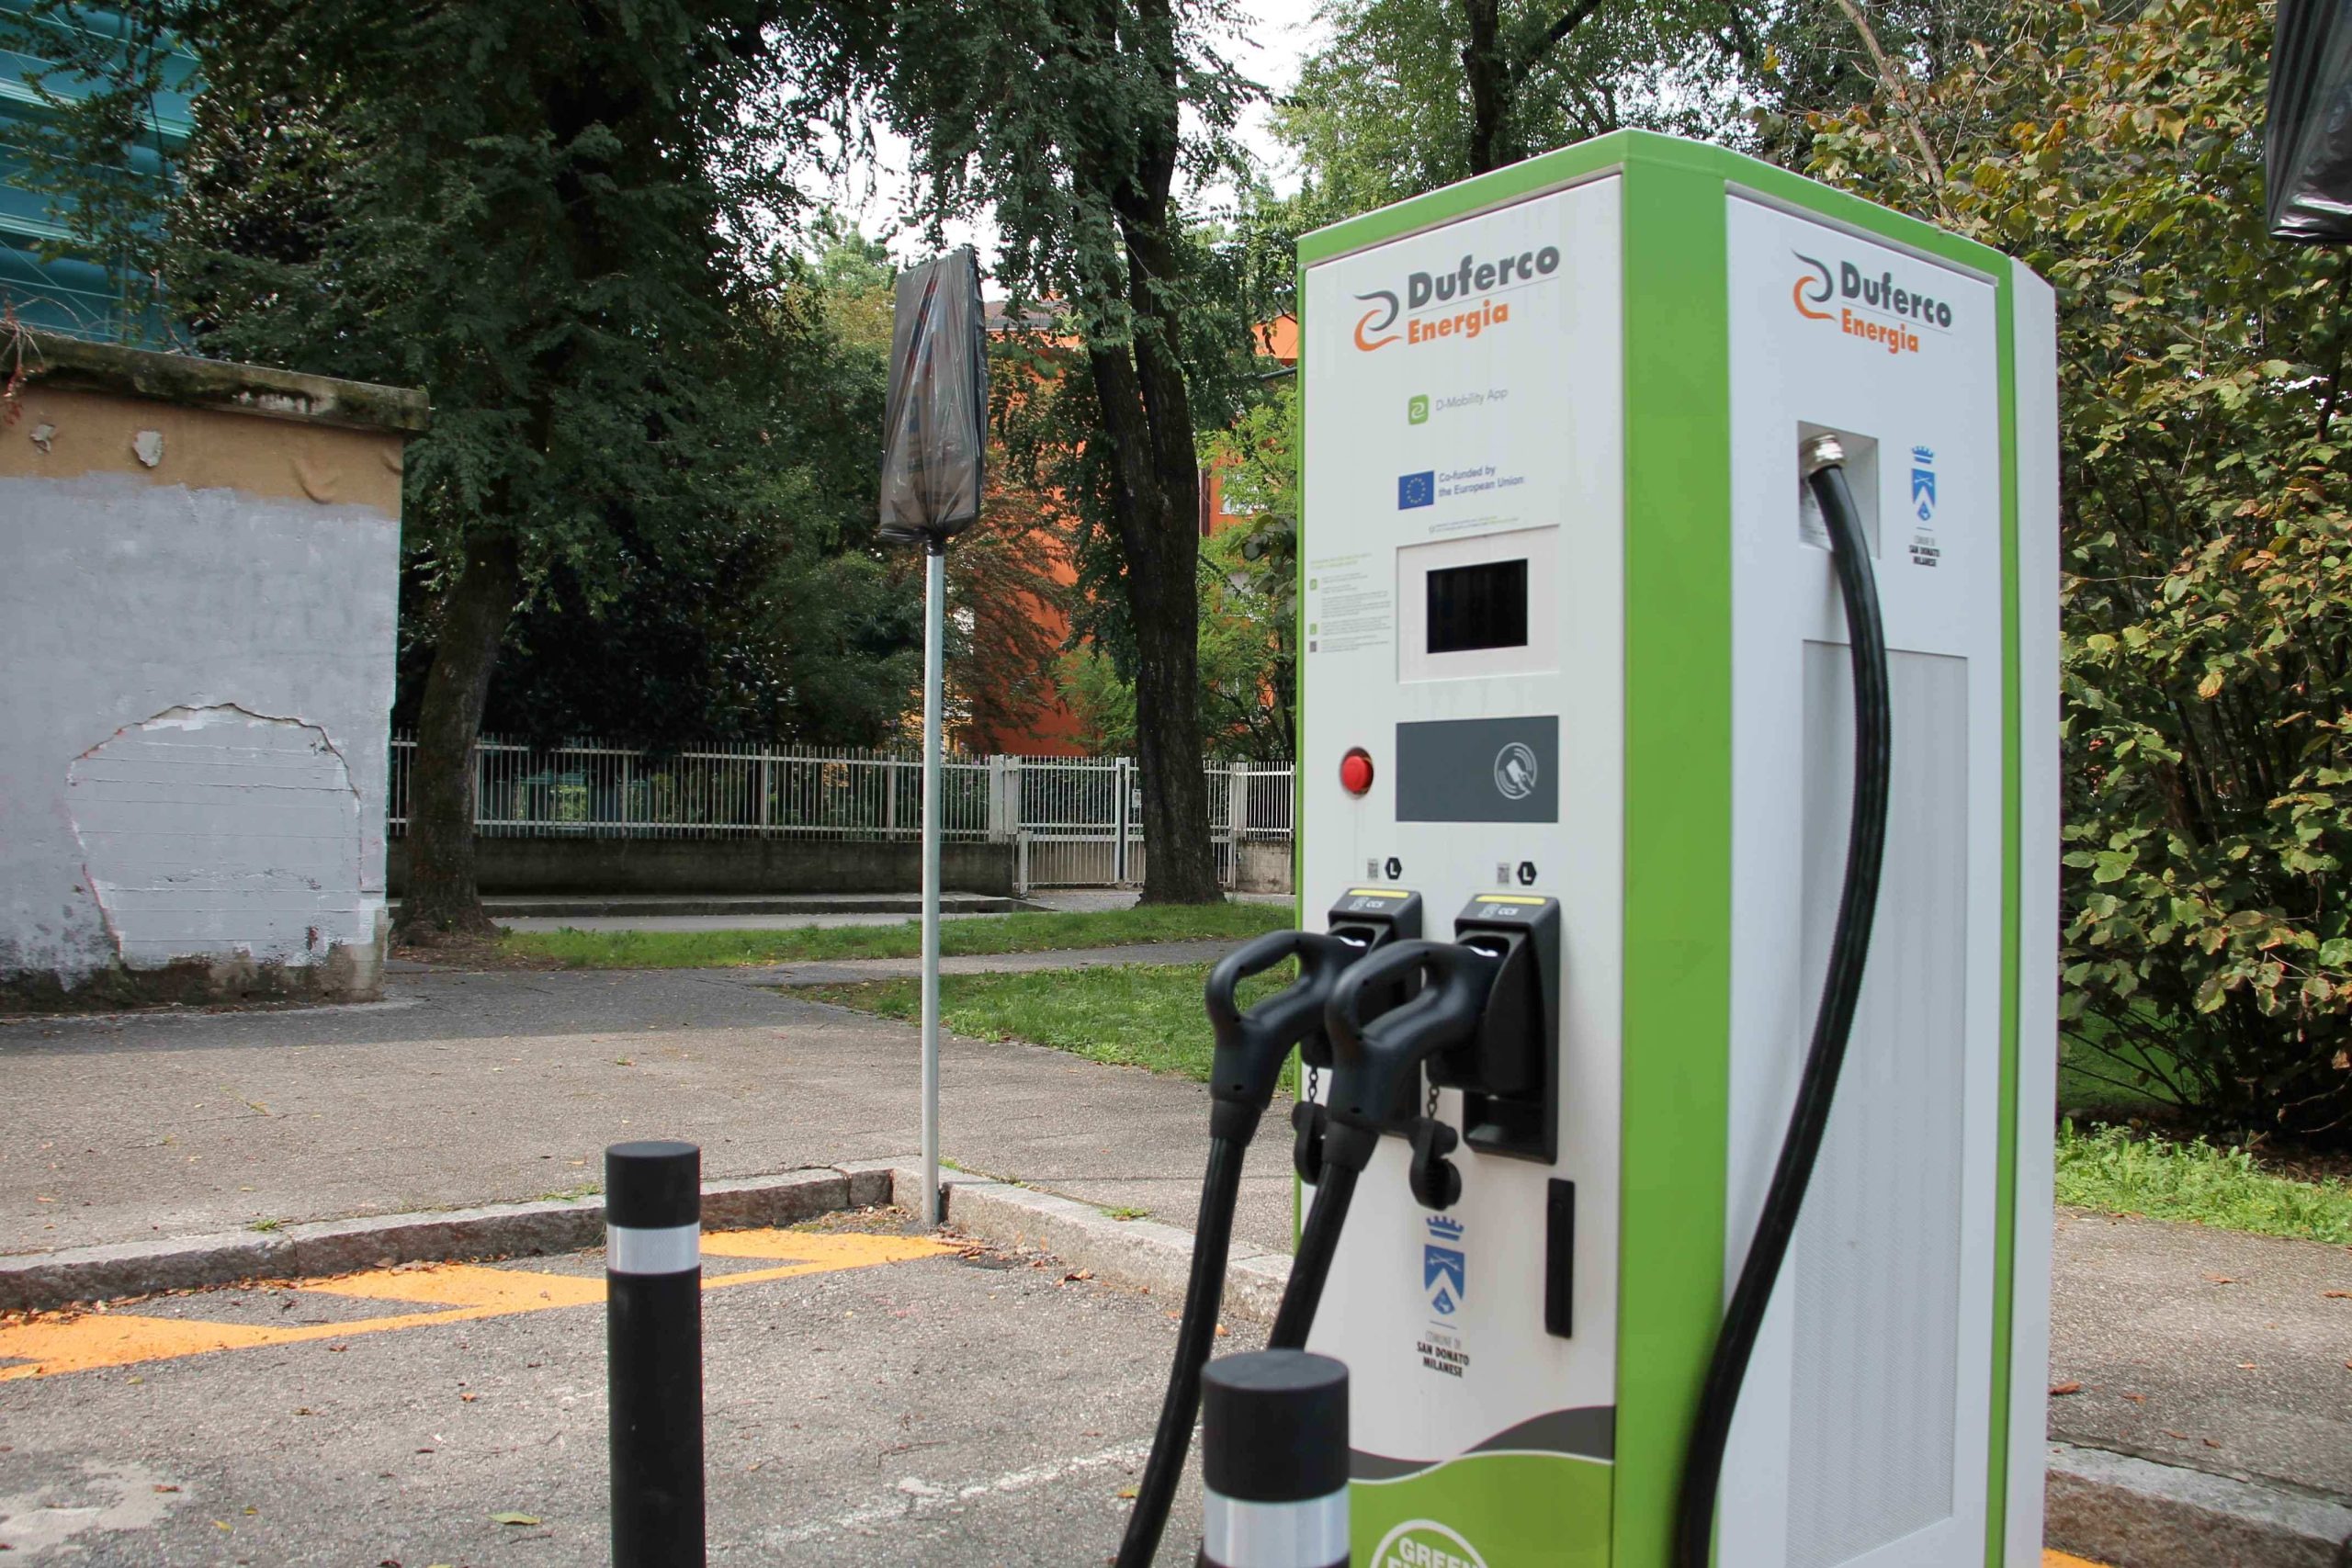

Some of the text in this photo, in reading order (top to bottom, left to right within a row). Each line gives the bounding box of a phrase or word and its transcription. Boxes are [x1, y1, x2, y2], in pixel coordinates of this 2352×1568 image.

[1408, 245, 1561, 310] Duferco
[1840, 260, 1952, 328] Duferco
[1408, 299, 1510, 345] Energia
[1841, 307, 1919, 355] Energia
[1435, 389, 1509, 412] D-Mobility App
[1438, 476, 1524, 497] the European Union
[1439, 465, 1497, 483] Co-funded by
[1416, 1340, 1470, 1367] SAN DONATO
[1422, 1356, 1463, 1379] MILANESE
